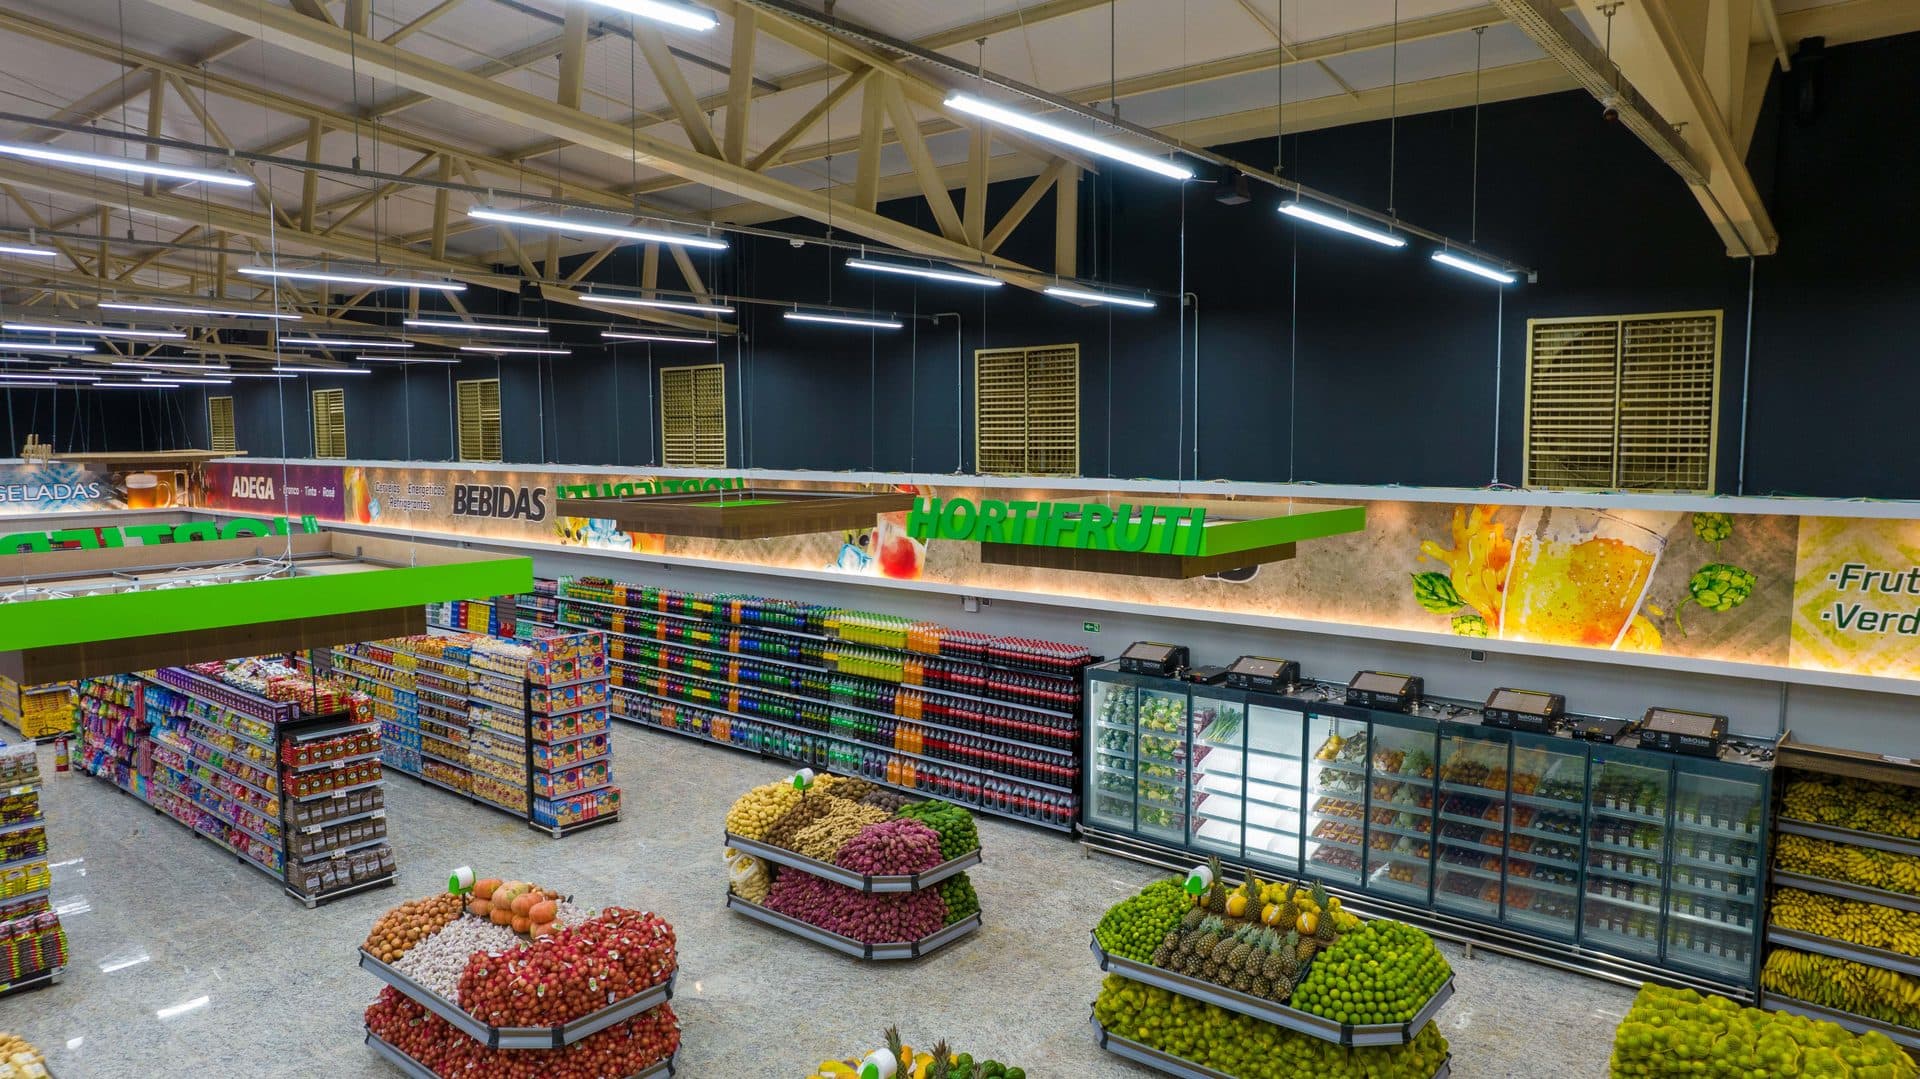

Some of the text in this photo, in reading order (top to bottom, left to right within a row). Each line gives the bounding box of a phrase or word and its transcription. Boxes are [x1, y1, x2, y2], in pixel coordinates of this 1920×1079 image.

[232, 476, 275, 500] ADEGA
[453, 484, 547, 522] BEBIDAS
[907, 497, 1207, 556] HORTIFRUTI
